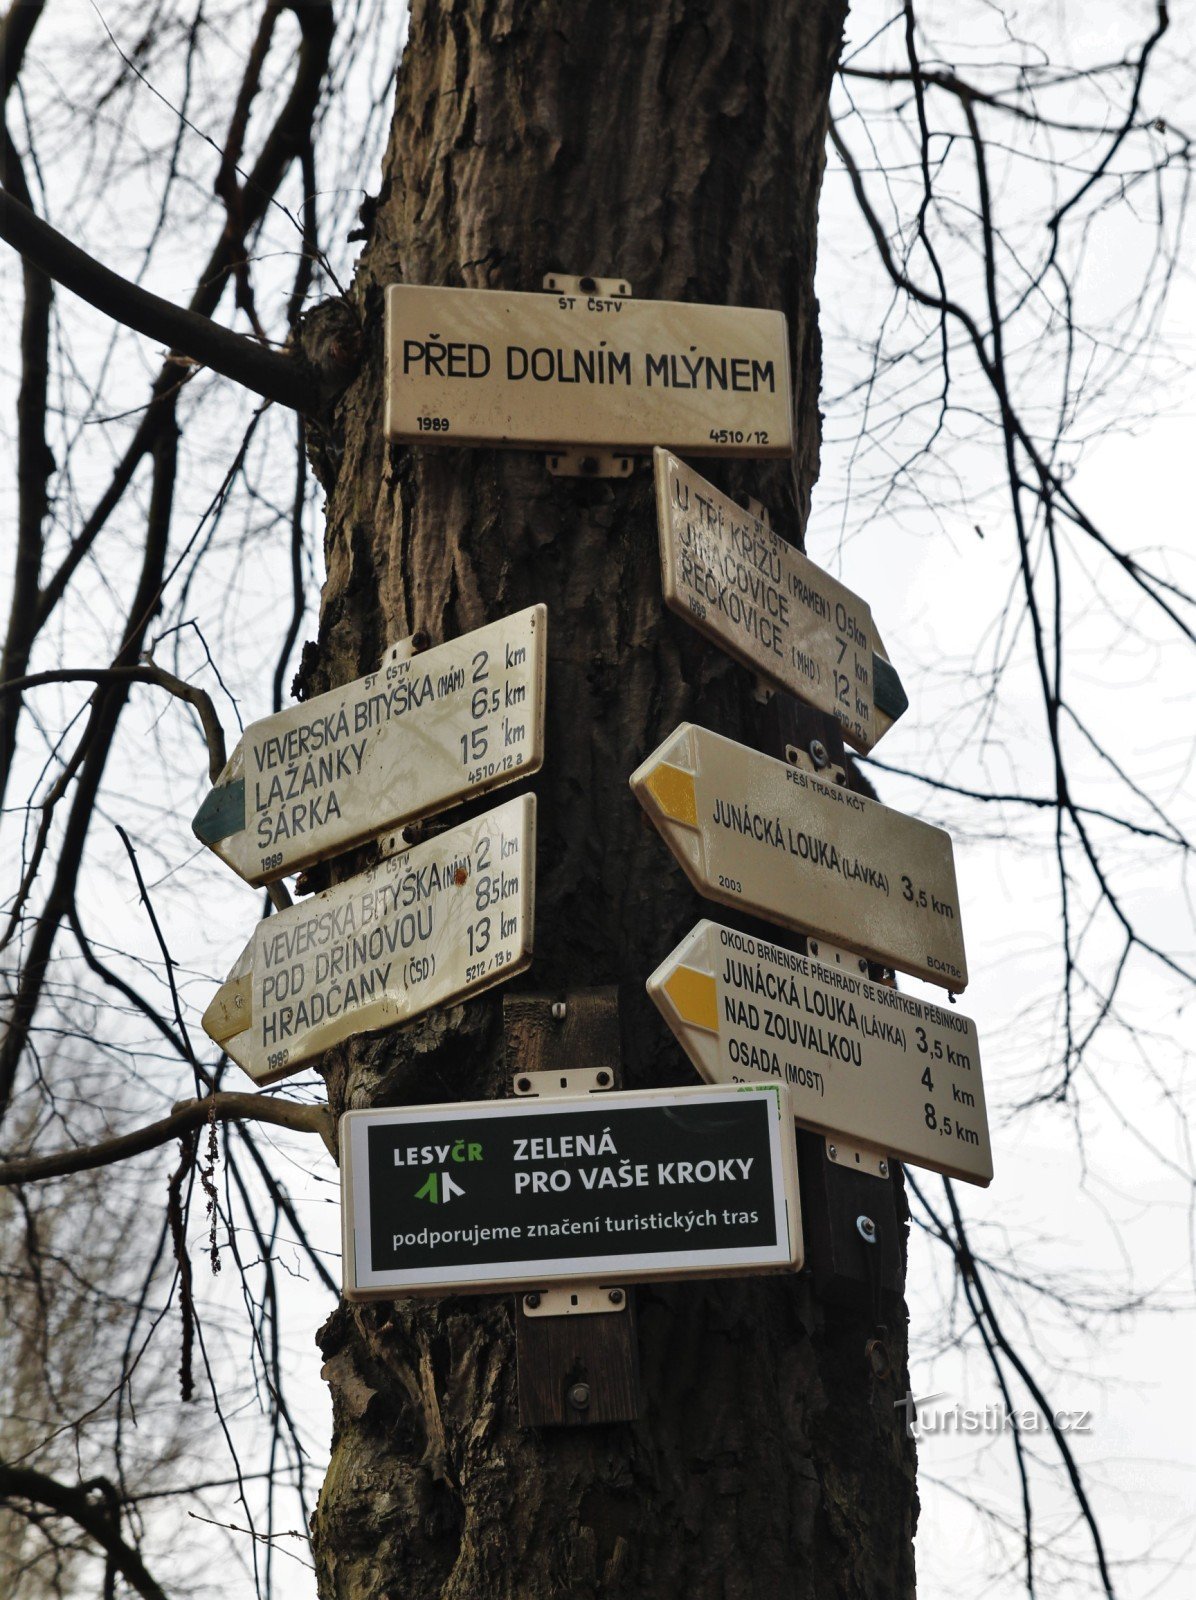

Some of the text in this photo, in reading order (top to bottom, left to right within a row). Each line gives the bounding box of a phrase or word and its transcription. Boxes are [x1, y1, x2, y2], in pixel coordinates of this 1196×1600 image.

[559, 297, 622, 312] ST ČSTV
[403, 333, 775, 393] PŘED DOLNÍM MLÝNEM
[416, 416, 450, 432] 1989
[676, 479, 688, 511] U
[730, 522, 781, 584] KŘÍŽŮ
[364, 660, 411, 690] ST ČSTV
[681, 547, 783, 658] ŘEČKOVICE
[833, 669, 850, 707] 12
[855, 687, 869, 721] km
[836, 635, 848, 664] 7
[854, 651, 868, 685] km
[253, 702, 350, 773] VEVERSKÁ
[354, 674, 435, 734] BITÝŠKA
[472, 651, 489, 684] 2
[505, 643, 526, 670] km
[256, 738, 367, 812] LAŽÁNKY
[505, 681, 526, 708] km
[257, 718, 525, 849] ŠÁRKA 15 km
[811, 780, 844, 804] TRASA
[846, 795, 866, 812] KČT
[261, 851, 283, 873] 1989
[262, 895, 356, 970] VEVERSKÁ
[361, 862, 442, 926] BITÝŠKA
[475, 836, 491, 873] 2
[500, 834, 519, 860] km
[712, 798, 954, 919] JUNÁCKÁ LOUKA (LÁVKA) 3,5 km
[718, 875, 742, 894] 2003
[262, 962, 305, 1009] POD
[315, 905, 433, 985] DŘÍNOVOU
[262, 962, 392, 1048] HRADČANY
[467, 916, 491, 957] 13
[500, 911, 517, 940] km
[720, 929, 755, 955] OKOLO
[811, 962, 861, 1000] PŘEHRADY
[863, 981, 876, 1000] SE
[877, 986, 923, 1018] SKŘÍTKEM
[924, 1005, 968, 1035] PĚŠINKOU
[267, 1049, 290, 1070] 1989
[723, 957, 971, 1070] JUNÁCKÁ LOUKA (LÁVKA) 3,5 km
[724, 996, 976, 1108] NAD ZOUVALKOU 4 km
[513, 1127, 618, 1161] ZELENÁ
[728, 1038, 979, 1146] OSADA (MOST) 8,5 km
[514, 1157, 754, 1194] PRO VAŠE KROKY
[392, 1208, 759, 1251] podporujeme značení turistických tras
